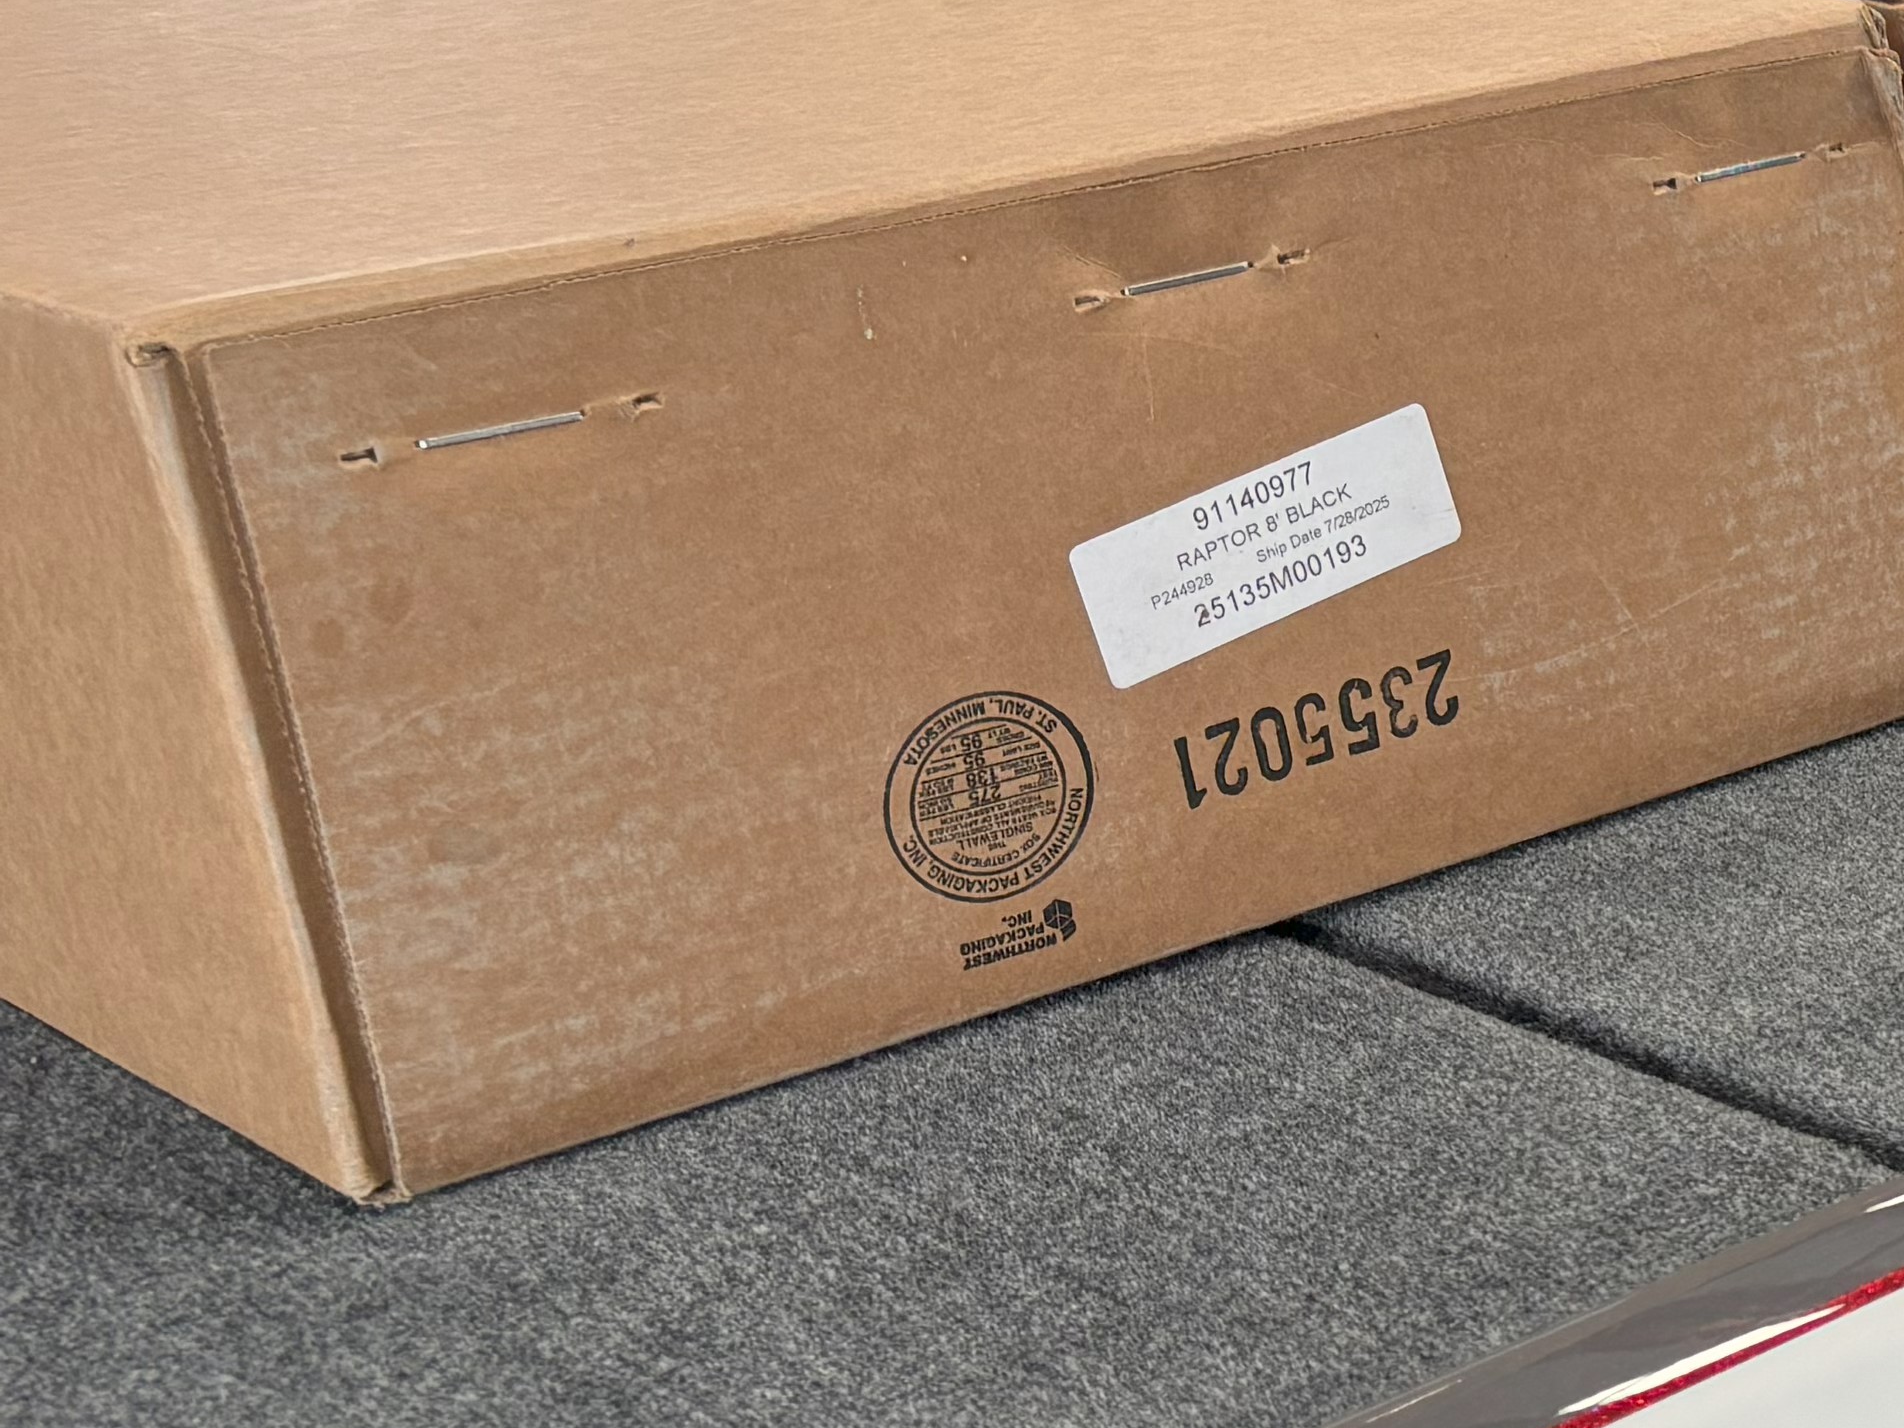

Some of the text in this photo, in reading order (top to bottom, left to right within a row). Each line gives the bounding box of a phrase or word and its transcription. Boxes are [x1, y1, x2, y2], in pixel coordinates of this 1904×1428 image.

[1192, 460, 1313, 531] 91140977
[1176, 482, 1353, 571] RAPTOR 8' BLACK
[1150, 494, 1392, 611] P244928 Ship Date 7/28/2025
[1193, 534, 1369, 628] 25135M00193
[989, 698, 1035, 722] PAUL,
[1038, 710, 1058, 734] ST.
[902, 698, 987, 767] MINNESOTA
[959, 733, 983, 752] 95
[1173, 648, 1459, 810] 2355021
[962, 751, 986, 769] 95
[964, 766, 999, 789] 138
[966, 784, 1003, 806] 275
[903, 787, 1084, 893] NORTHWEST PACKAGING, INC.
[956, 822, 1034, 851] SINGLEWALL
[950, 849, 1020, 869] CERTIFICATE
[1001, 909, 1033, 928] INC.
[959, 921, 1044, 957] PACKAGING
[963, 933, 1058, 971] NORTHWEST
